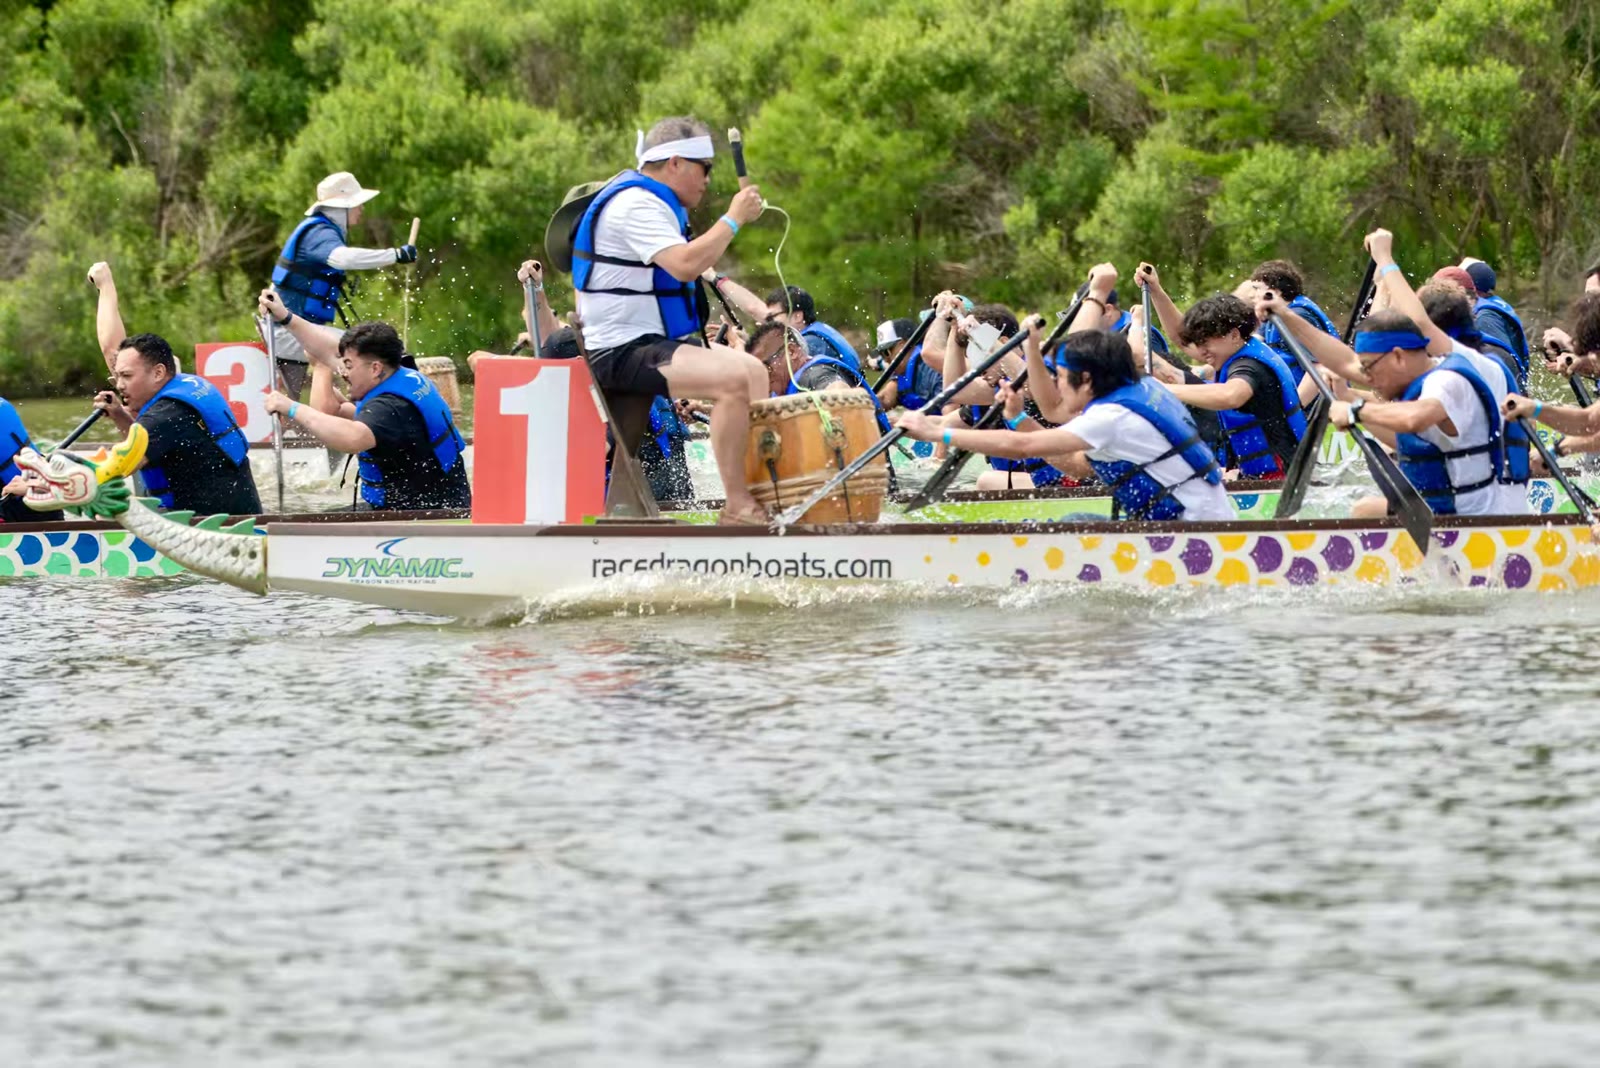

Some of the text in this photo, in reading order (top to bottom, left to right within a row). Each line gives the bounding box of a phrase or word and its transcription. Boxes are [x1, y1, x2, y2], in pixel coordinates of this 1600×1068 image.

[204, 345, 274, 442] 3
[500, 366, 570, 523] 1
[322, 557, 463, 578] DYNAMIC
